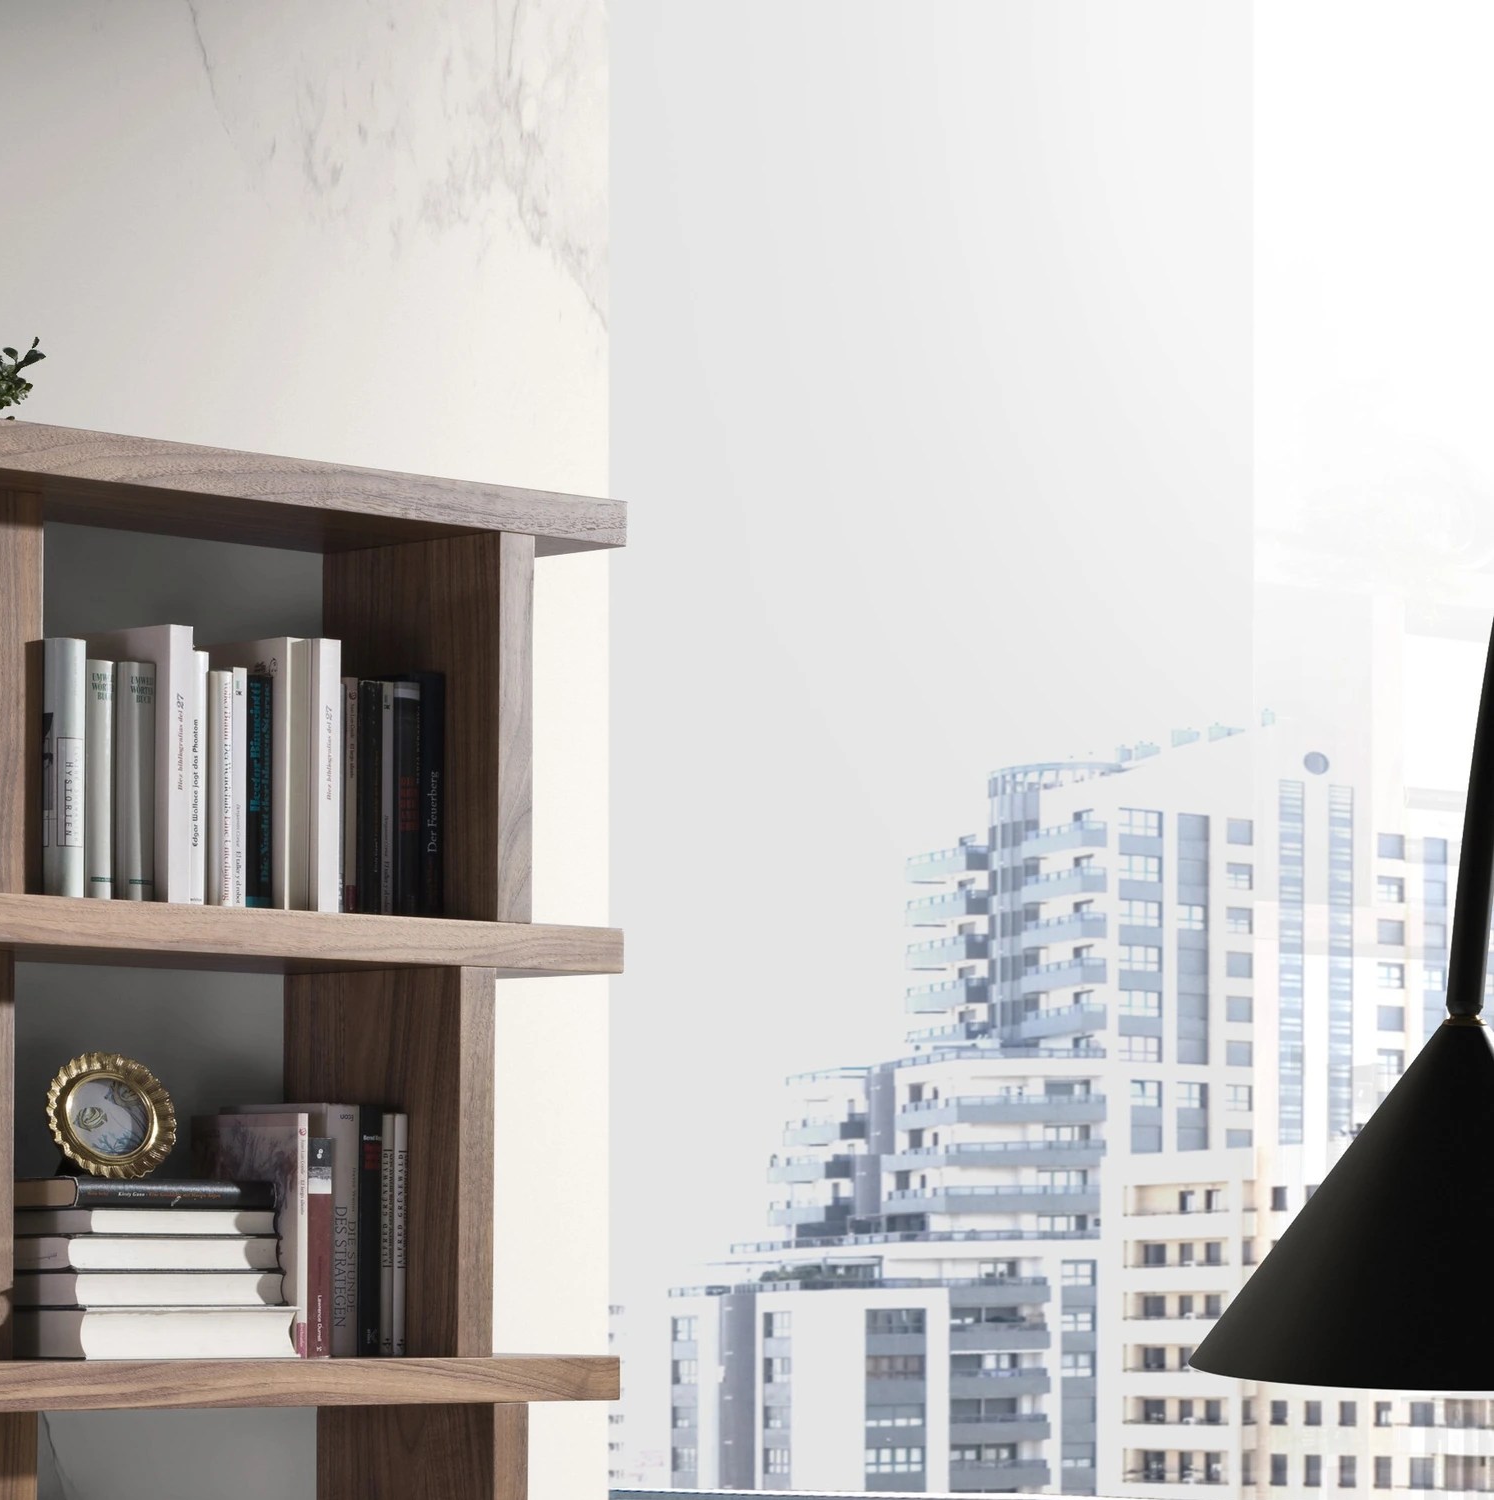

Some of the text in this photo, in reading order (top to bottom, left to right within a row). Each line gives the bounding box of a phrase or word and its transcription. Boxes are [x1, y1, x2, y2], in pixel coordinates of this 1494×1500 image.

[427, 770, 440, 853] Der Feuerberg
[333, 1206, 348, 1328] DES STRATEGEN
[347, 1221, 356, 1246] DIE
[346, 1250, 356, 1313] STUNDE
